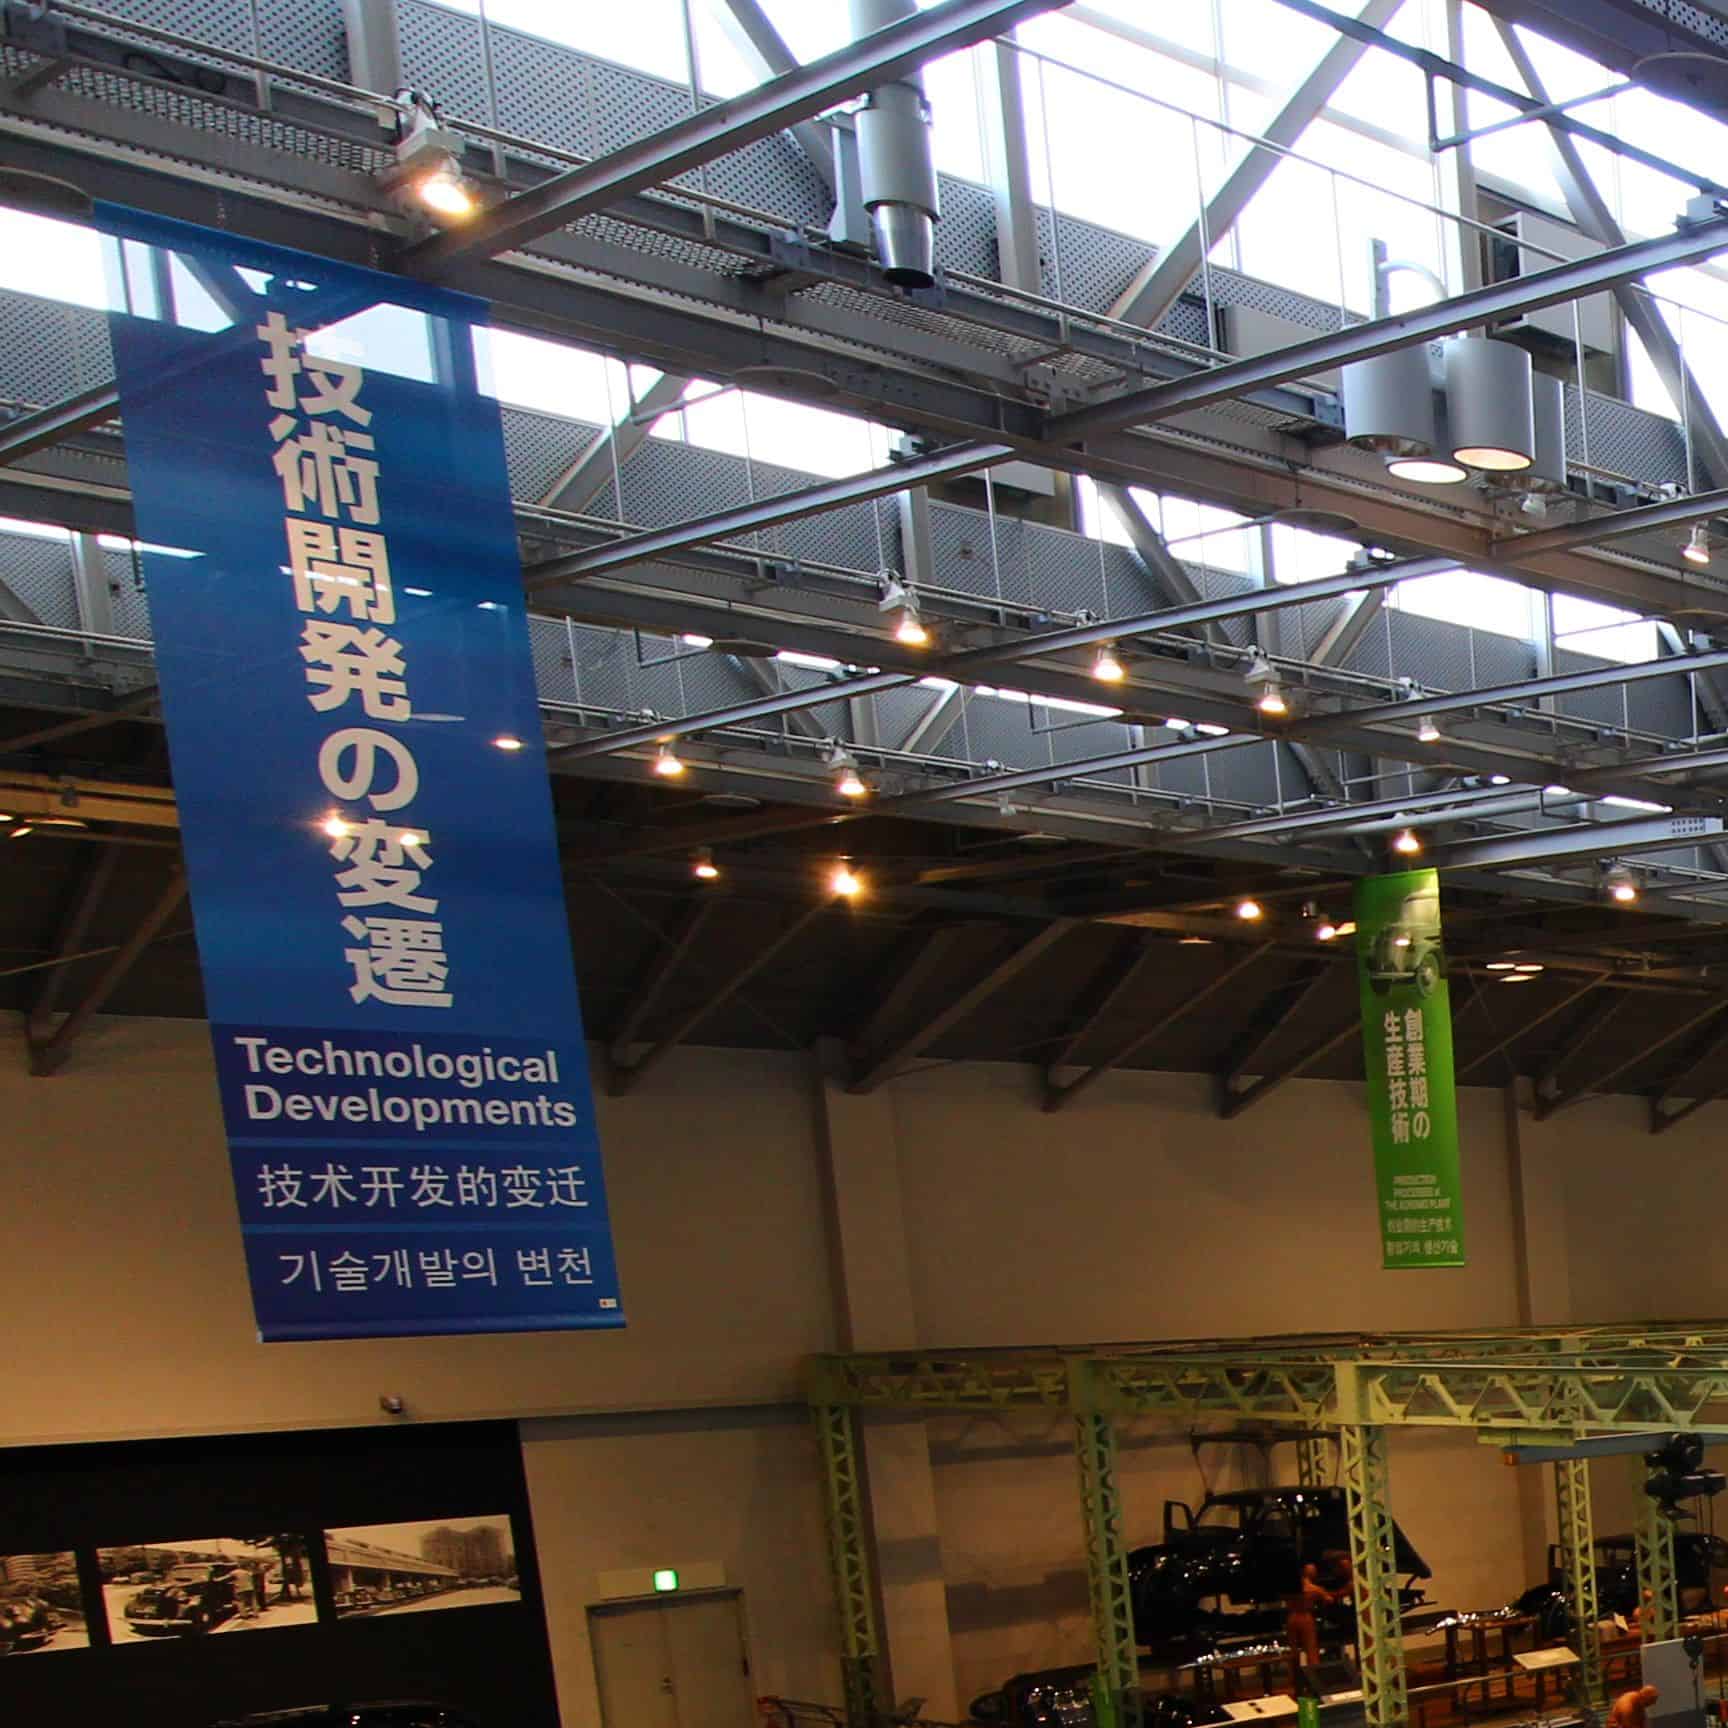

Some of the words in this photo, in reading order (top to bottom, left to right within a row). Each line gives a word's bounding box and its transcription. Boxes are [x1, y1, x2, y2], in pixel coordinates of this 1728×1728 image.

[257, 310, 454, 1008] 技術開発の変遷
[234, 1036, 560, 1088] Technological
[1384, 1010, 1409, 1144] 生産技術
[1404, 1008, 1431, 1139] 創業期の
[244, 1084, 577, 1131] Developments
[256, 1163, 589, 1208] 技术开发的变迁
[279, 1248, 498, 1292] 기술개발의
[516, 1247, 594, 1287] 변천
